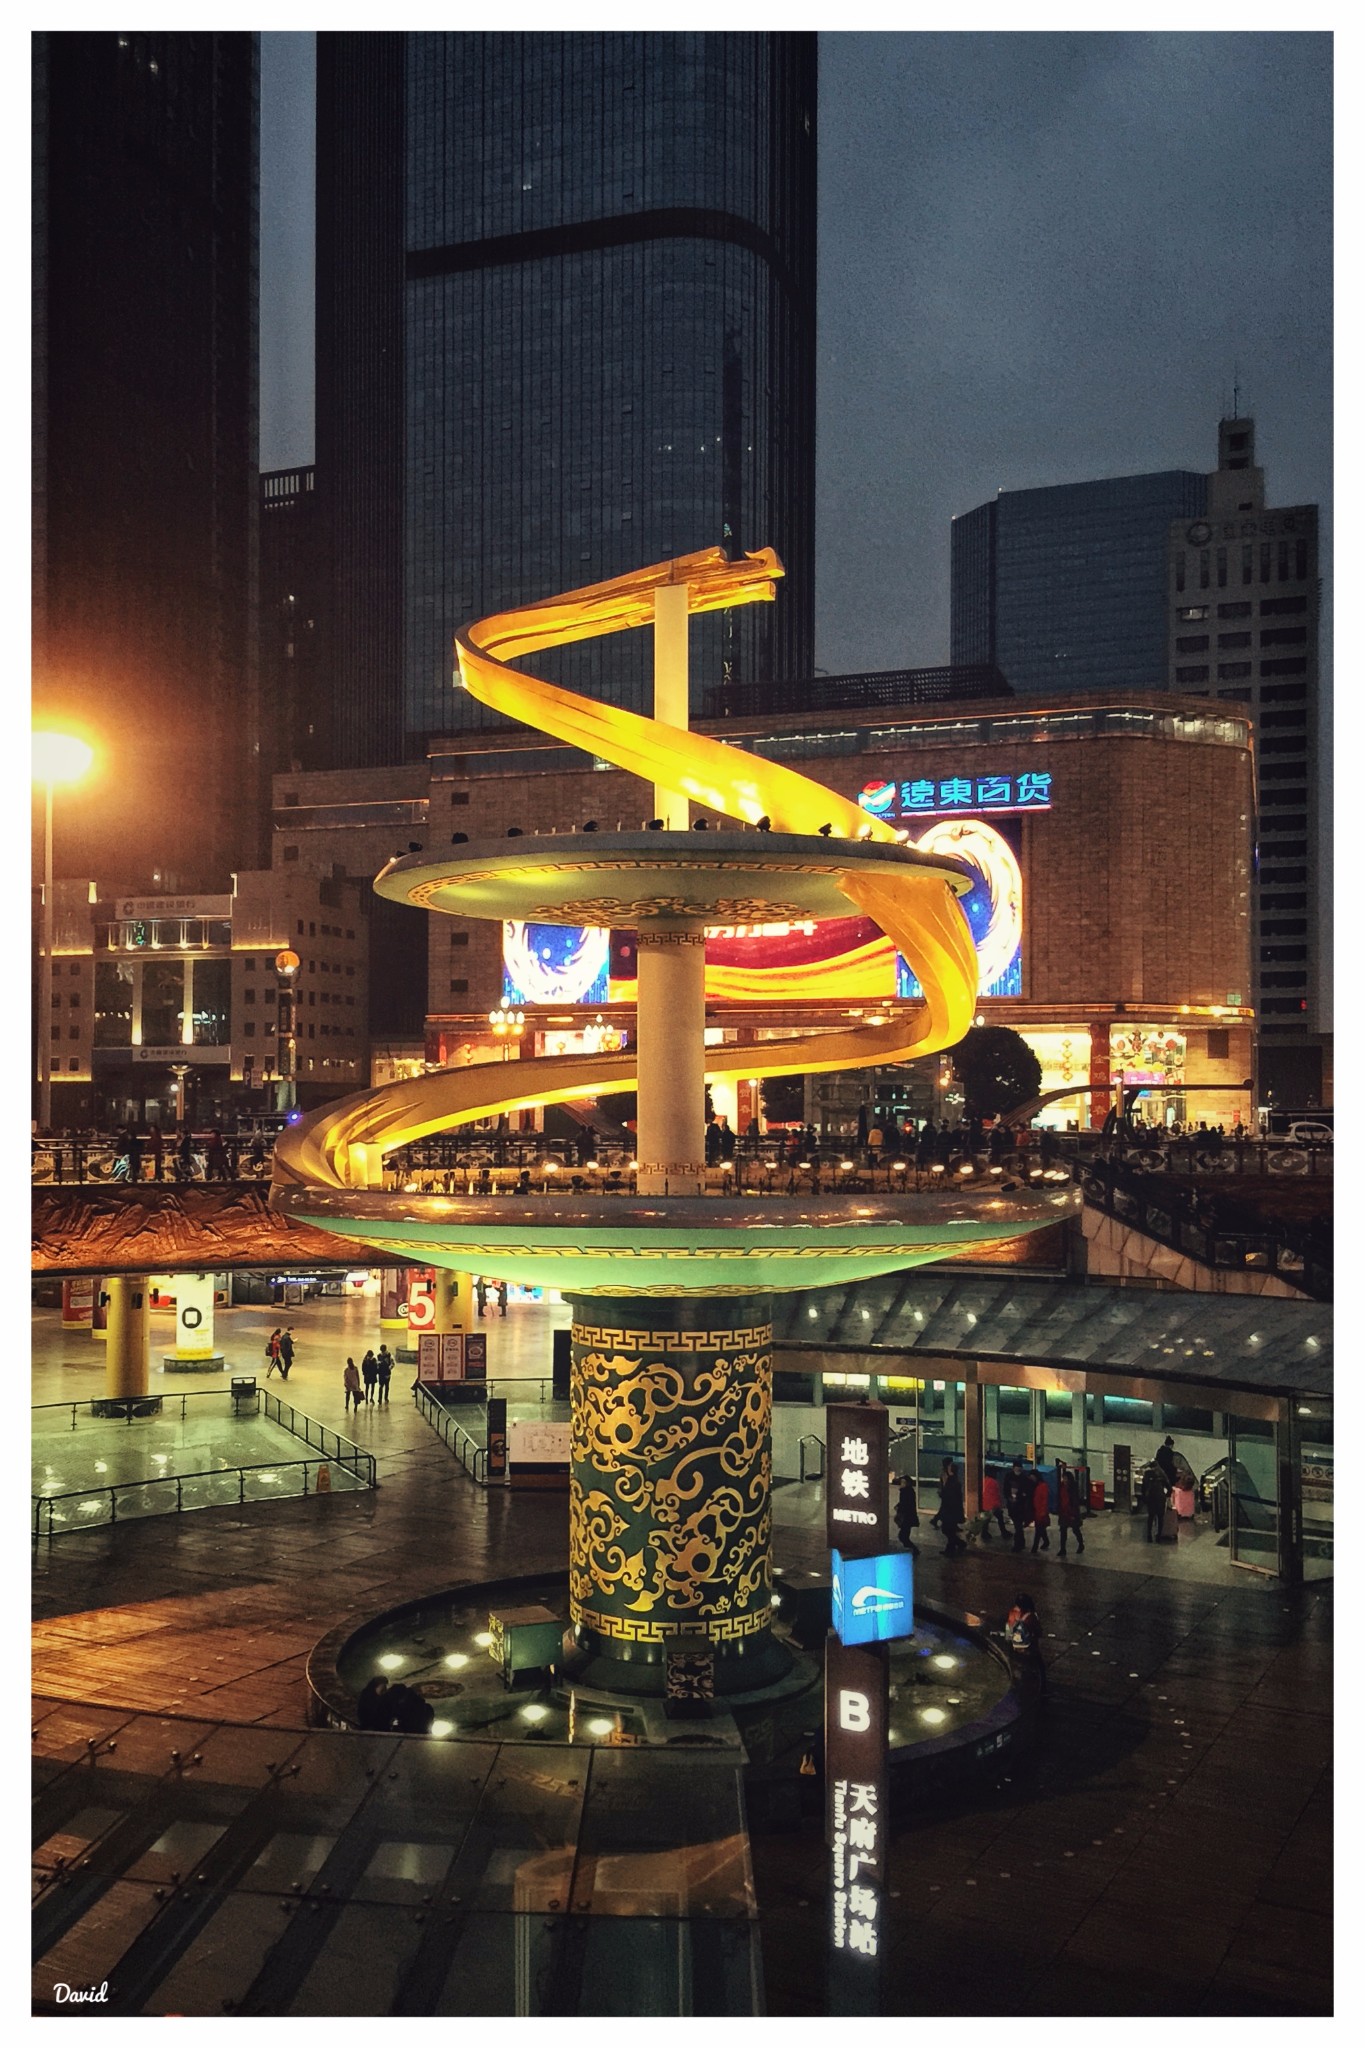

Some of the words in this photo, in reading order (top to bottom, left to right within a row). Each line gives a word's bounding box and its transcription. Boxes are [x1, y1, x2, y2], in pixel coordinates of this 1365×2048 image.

[409, 1282, 435, 1326] 5
[841, 1436, 869, 1498] 地铁
[833, 1508, 877, 1525] METRO
[840, 1690, 870, 1732] B
[834, 1780, 847, 1829] Tianfu
[832, 1832, 847, 1888] Square
[849, 1784, 878, 1956] 天府广场站
[834, 1891, 847, 1948] Station
